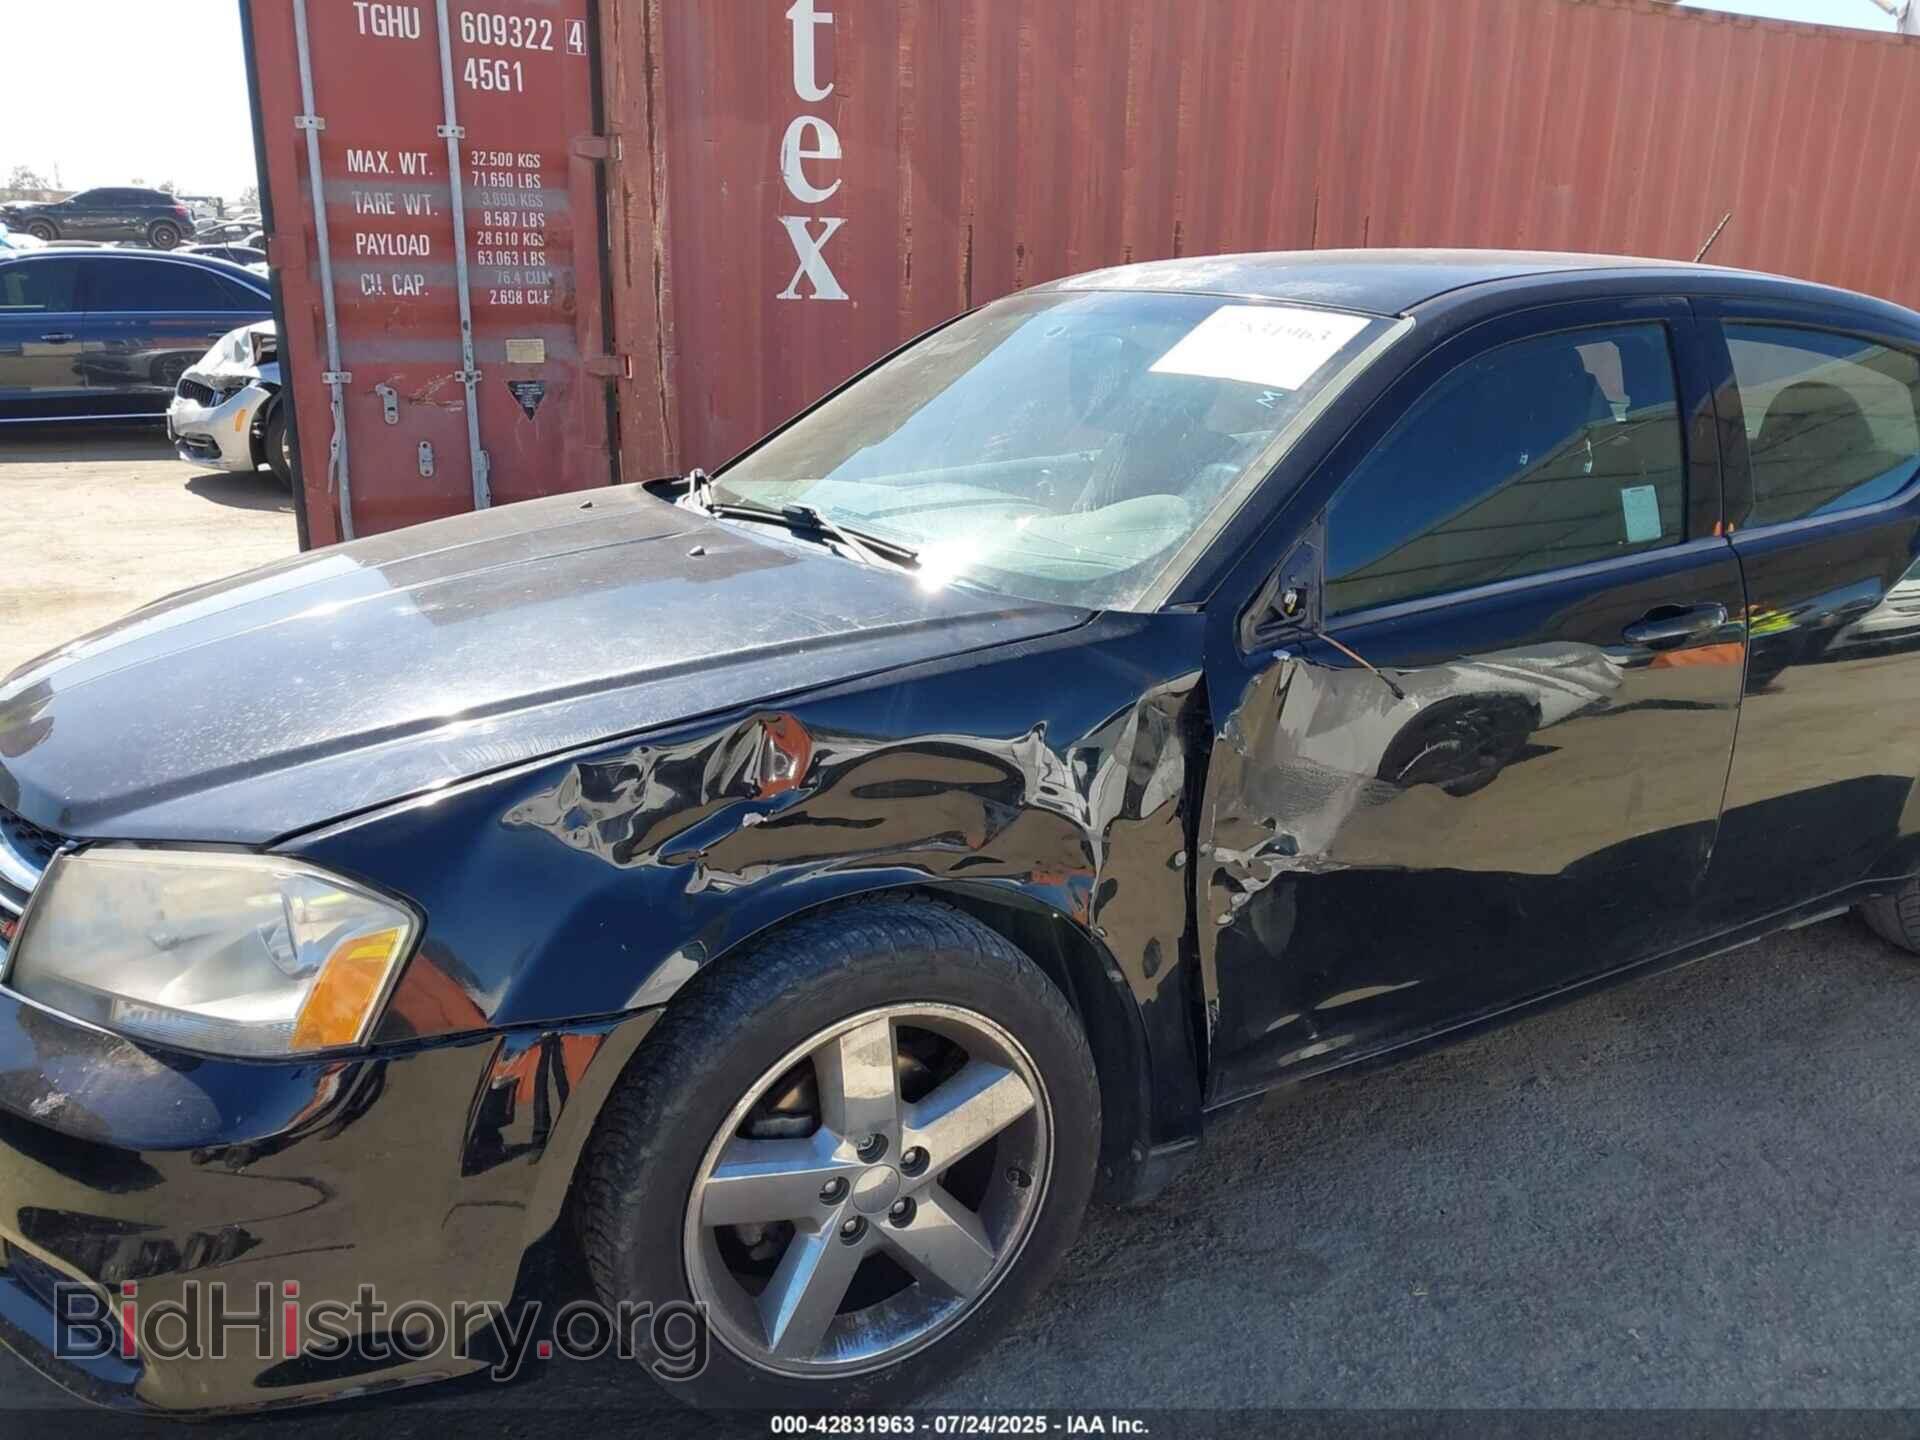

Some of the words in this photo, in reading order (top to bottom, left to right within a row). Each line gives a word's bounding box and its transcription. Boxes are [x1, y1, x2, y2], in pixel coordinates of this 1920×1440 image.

[353, 2, 420, 39] TGHU
[460, 11, 553, 51] 609322
[568, 21, 583, 53] 4
[463, 57, 523, 92] 45G1
[471, 151, 513, 167] 32.500
[518, 153, 541, 168] KGS
[776, 0, 849, 300] tex
[347, 149, 394, 174] MAX.
[398, 152, 433, 175] WT.
[471, 171, 513, 187] 71.650
[518, 173, 541, 189] LBS
[352, 191, 396, 215] TARE
[402, 193, 438, 216] WT.
[484, 211, 517, 226] 8.587
[522, 212, 544, 227] LBS
[355, 233, 430, 256] PAYLOAD
[477, 231, 518, 246] 28.610
[478, 250, 519, 265] 63.063
[523, 251, 545, 266] LBS
[361, 273, 386, 296] CU.
[392, 273, 429, 296] CAP.
